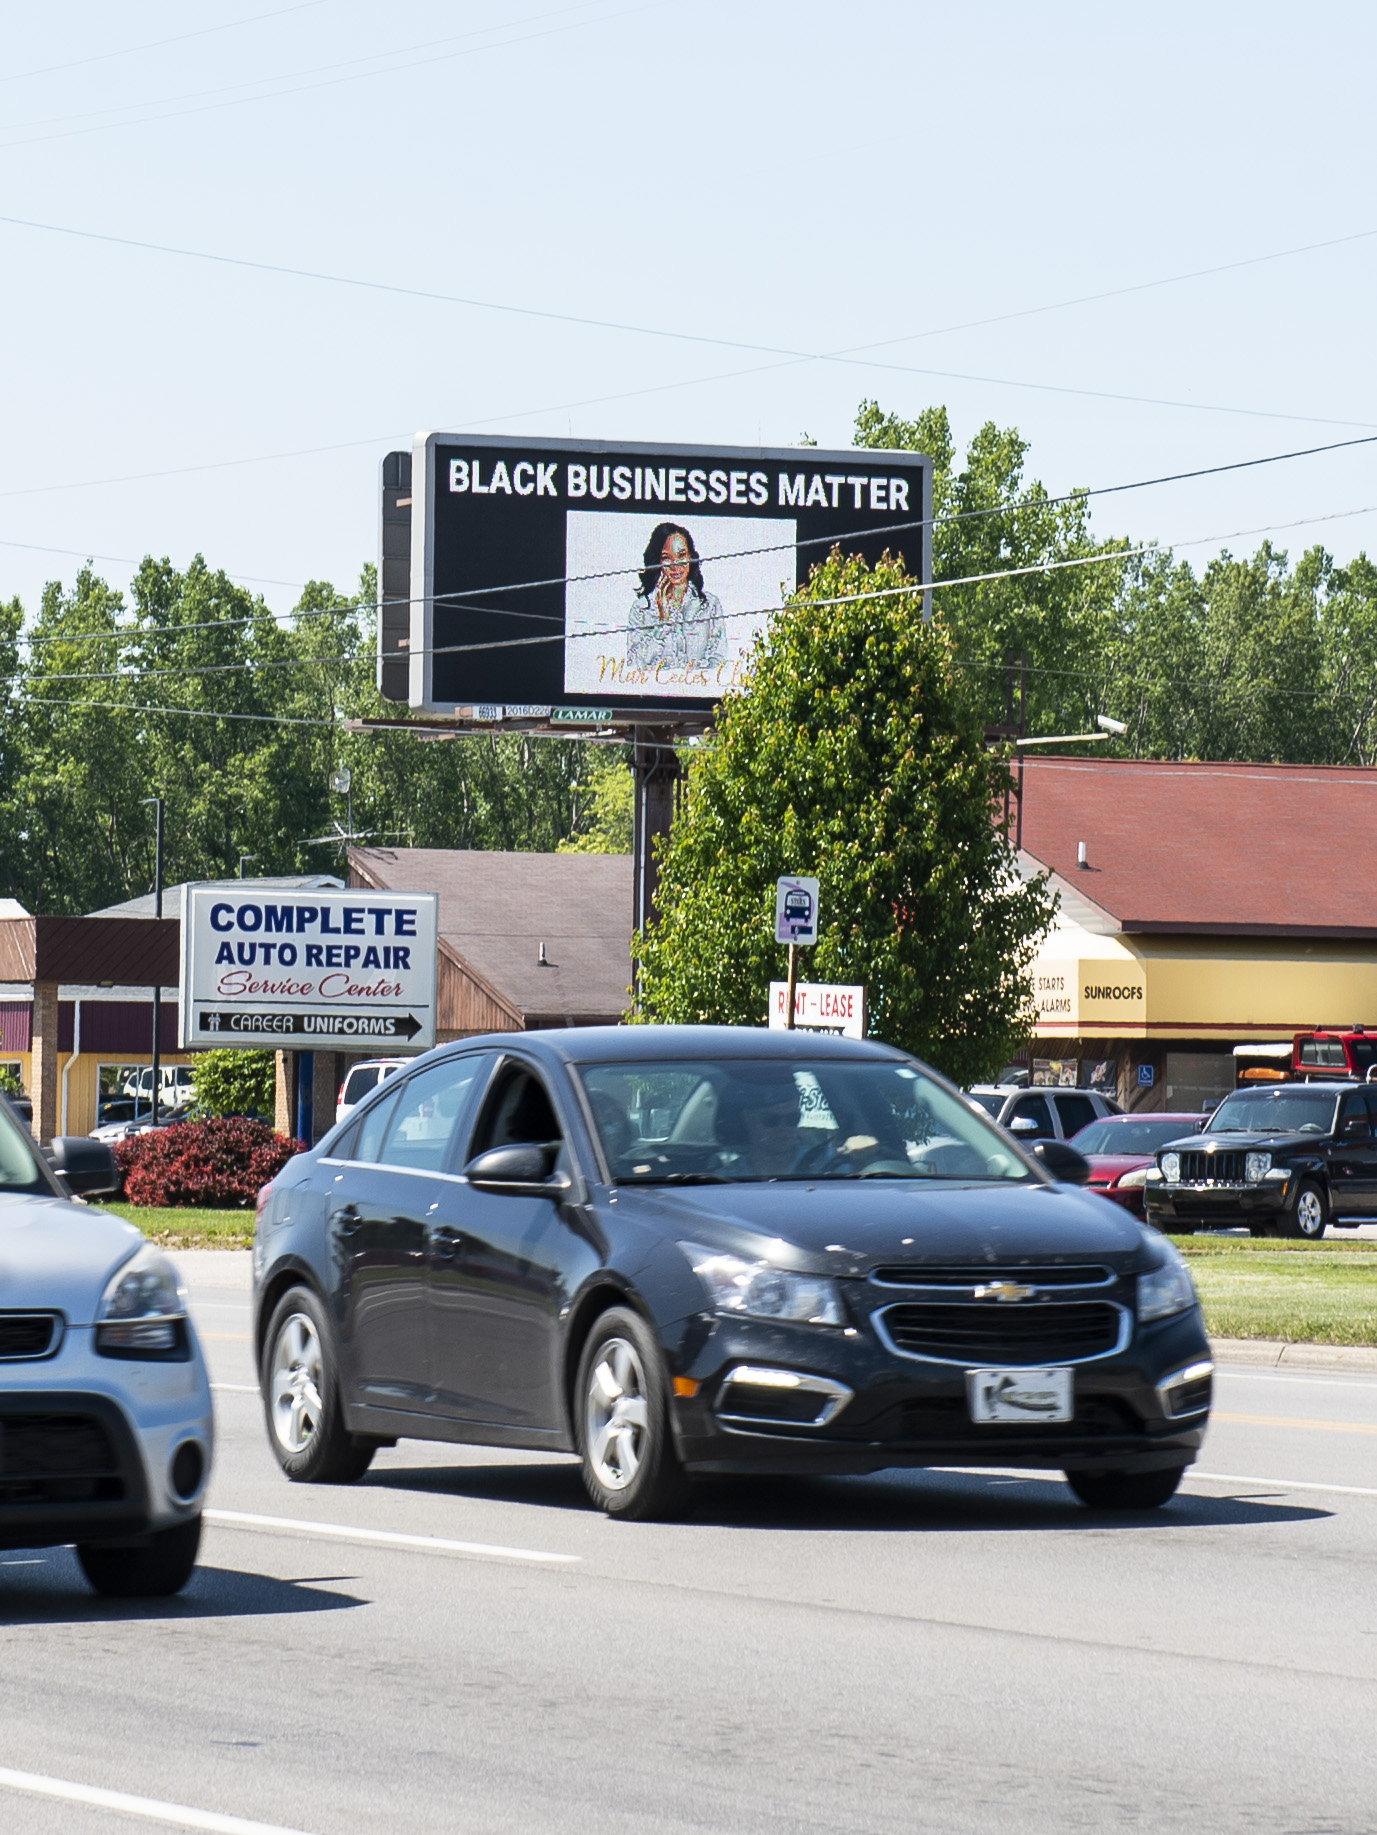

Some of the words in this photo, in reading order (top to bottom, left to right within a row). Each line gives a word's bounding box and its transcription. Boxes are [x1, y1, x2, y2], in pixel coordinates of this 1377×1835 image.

[449, 458, 558, 497] BLACK
[567, 464, 769, 506] BUSINESSES
[778, 472, 910, 511] MATTER
[557, 709, 608, 721] LAMAR
[210, 902, 417, 936] COMPLETE
[215, 941, 298, 967] AUTO
[305, 943, 411, 970] REPAIR
[217, 970, 314, 996] Service
[318, 973, 404, 998] Center
[1038, 977, 1065, 991] STARTS
[778, 990, 807, 1016] RNT
[820, 992, 853, 1018] LEASE
[1041, 998, 1071, 1013] ALARMS
[230, 1014, 294, 1032] CAREER
[303, 1016, 396, 1035] UNIFORMS
